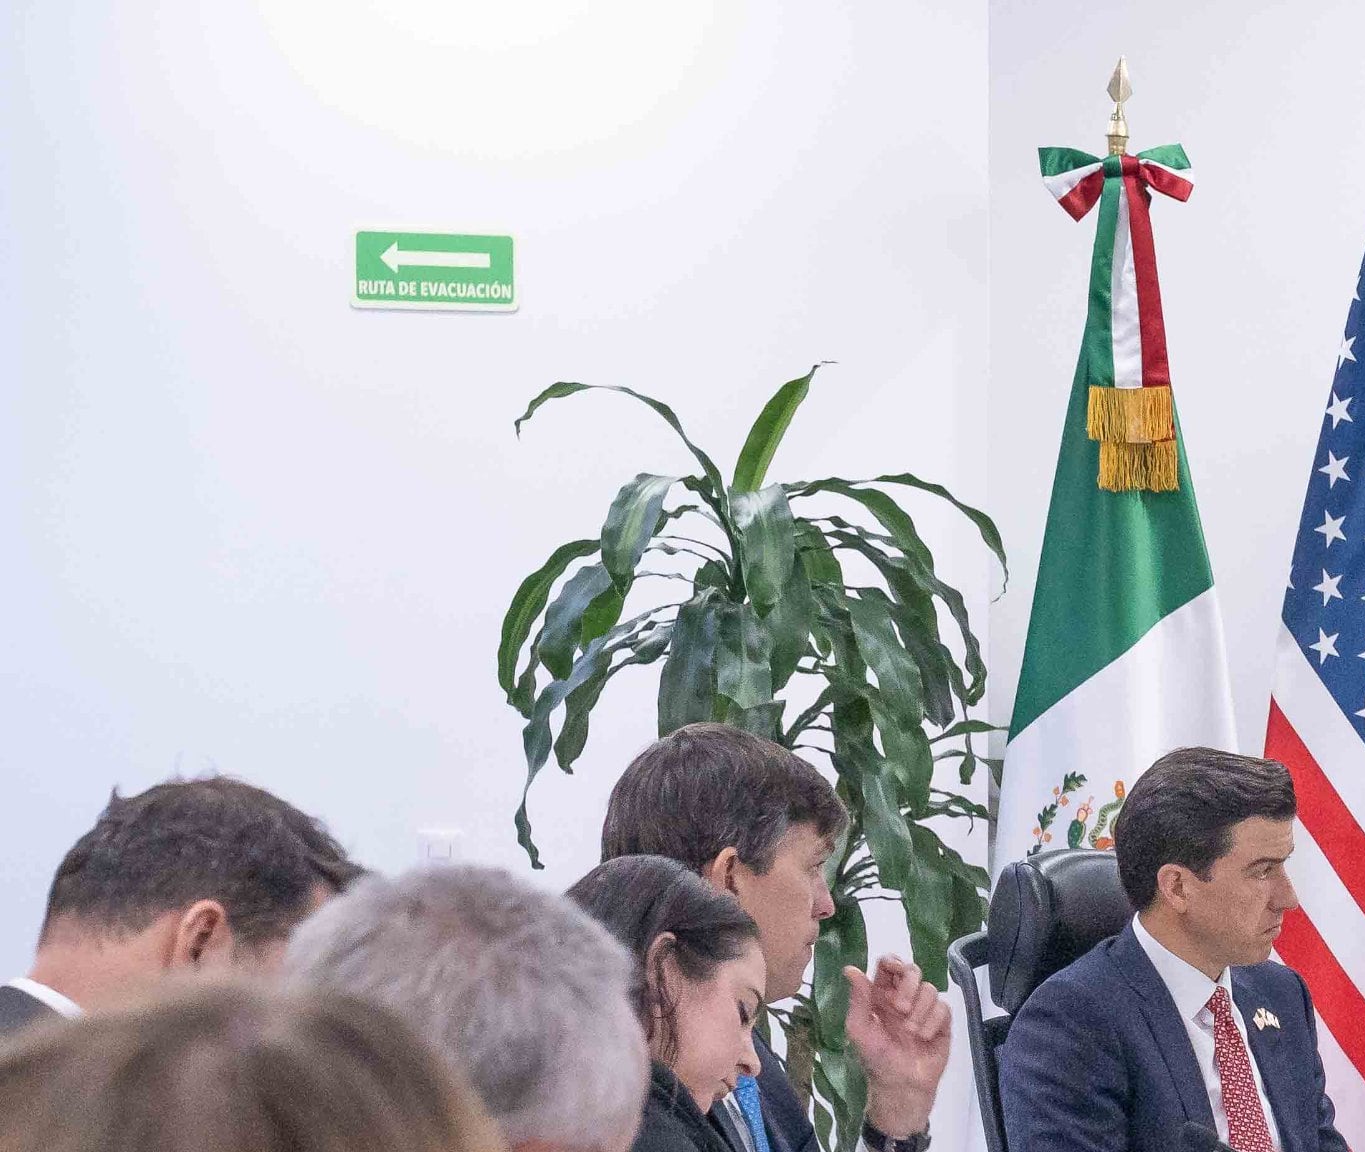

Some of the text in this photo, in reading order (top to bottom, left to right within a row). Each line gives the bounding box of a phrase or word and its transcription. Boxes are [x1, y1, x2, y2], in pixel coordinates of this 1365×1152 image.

[359, 280, 512, 298] RUTA DE EVACUACIÓN
